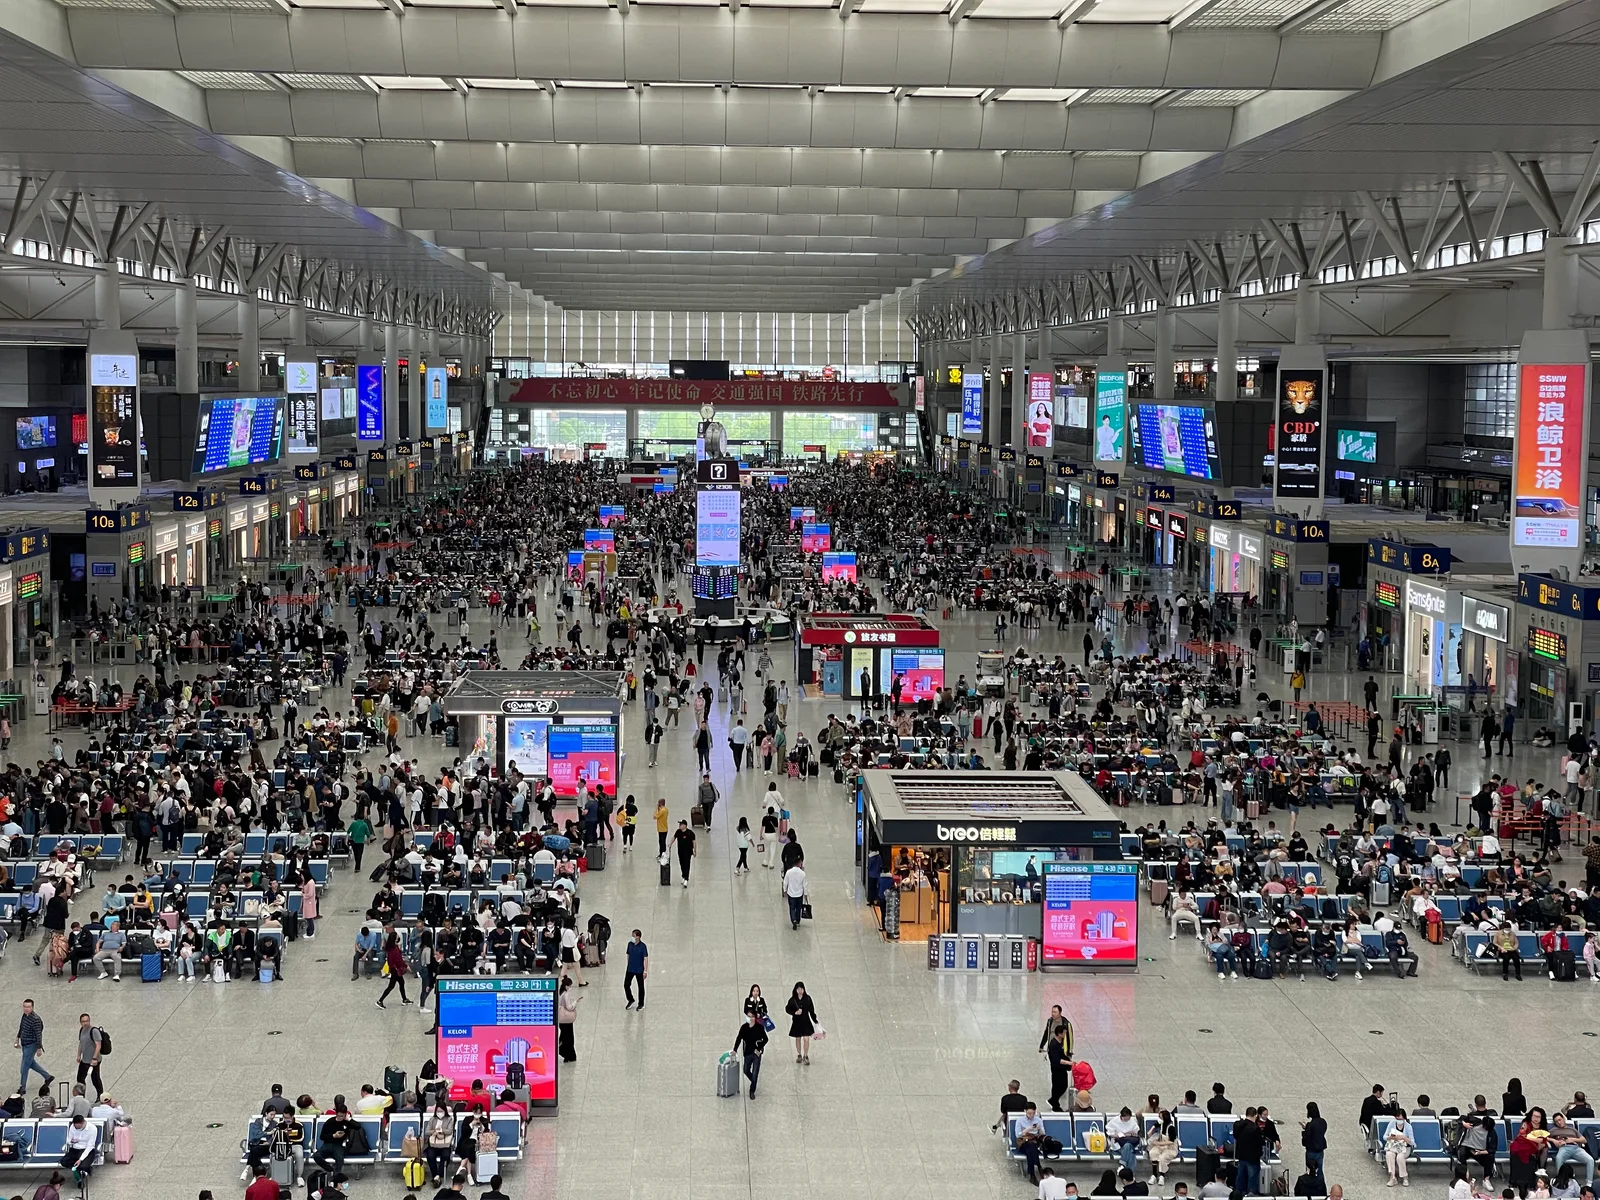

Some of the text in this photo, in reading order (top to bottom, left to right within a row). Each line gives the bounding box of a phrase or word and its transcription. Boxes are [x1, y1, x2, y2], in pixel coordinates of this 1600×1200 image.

[1539, 375, 1567, 383] SSWW
[547, 382, 864, 402] 不忘初心 牢记使命 交通强国 铁路先行
[296, 399, 305, 440] 全屋定制
[306, 400, 316, 430] 兔宝宝
[1283, 422, 1316, 434] CBD
[420, 440, 432, 448] 24B
[1535, 401, 1565, 489] 浪鲸卫浴
[398, 446, 410, 454] 22B
[979, 446, 990, 454] 24A
[1001, 451, 1014, 460] 22A
[371, 452, 385, 460] 20B
[338, 459, 353, 468] 18B
[1028, 458, 1042, 467] 20A
[299, 468, 314, 478] 16B
[1061, 466, 1075, 475] 18A
[243, 480, 262, 491] 14B
[1100, 476, 1116, 485] 16A
[1153, 488, 1171, 499] 14A
[178, 495, 198, 507] 12B
[1218, 505, 1237, 516] 12A
[92, 515, 115, 528] 10B
[1302, 525, 1324, 538] 10A
[1403, 552, 1410, 566] 8A
[1422, 553, 1440, 568] 8A
[1520, 580, 1529, 598] 7A
[1547, 586, 1560, 599] 检票口
[1571, 593, 1581, 611] 6A
[861, 632, 896, 642] 旅友书屋
[937, 824, 979, 841] breo
[1050, 864, 1089, 873] Hisense
[445, 980, 529, 990] Hisense 2-30
